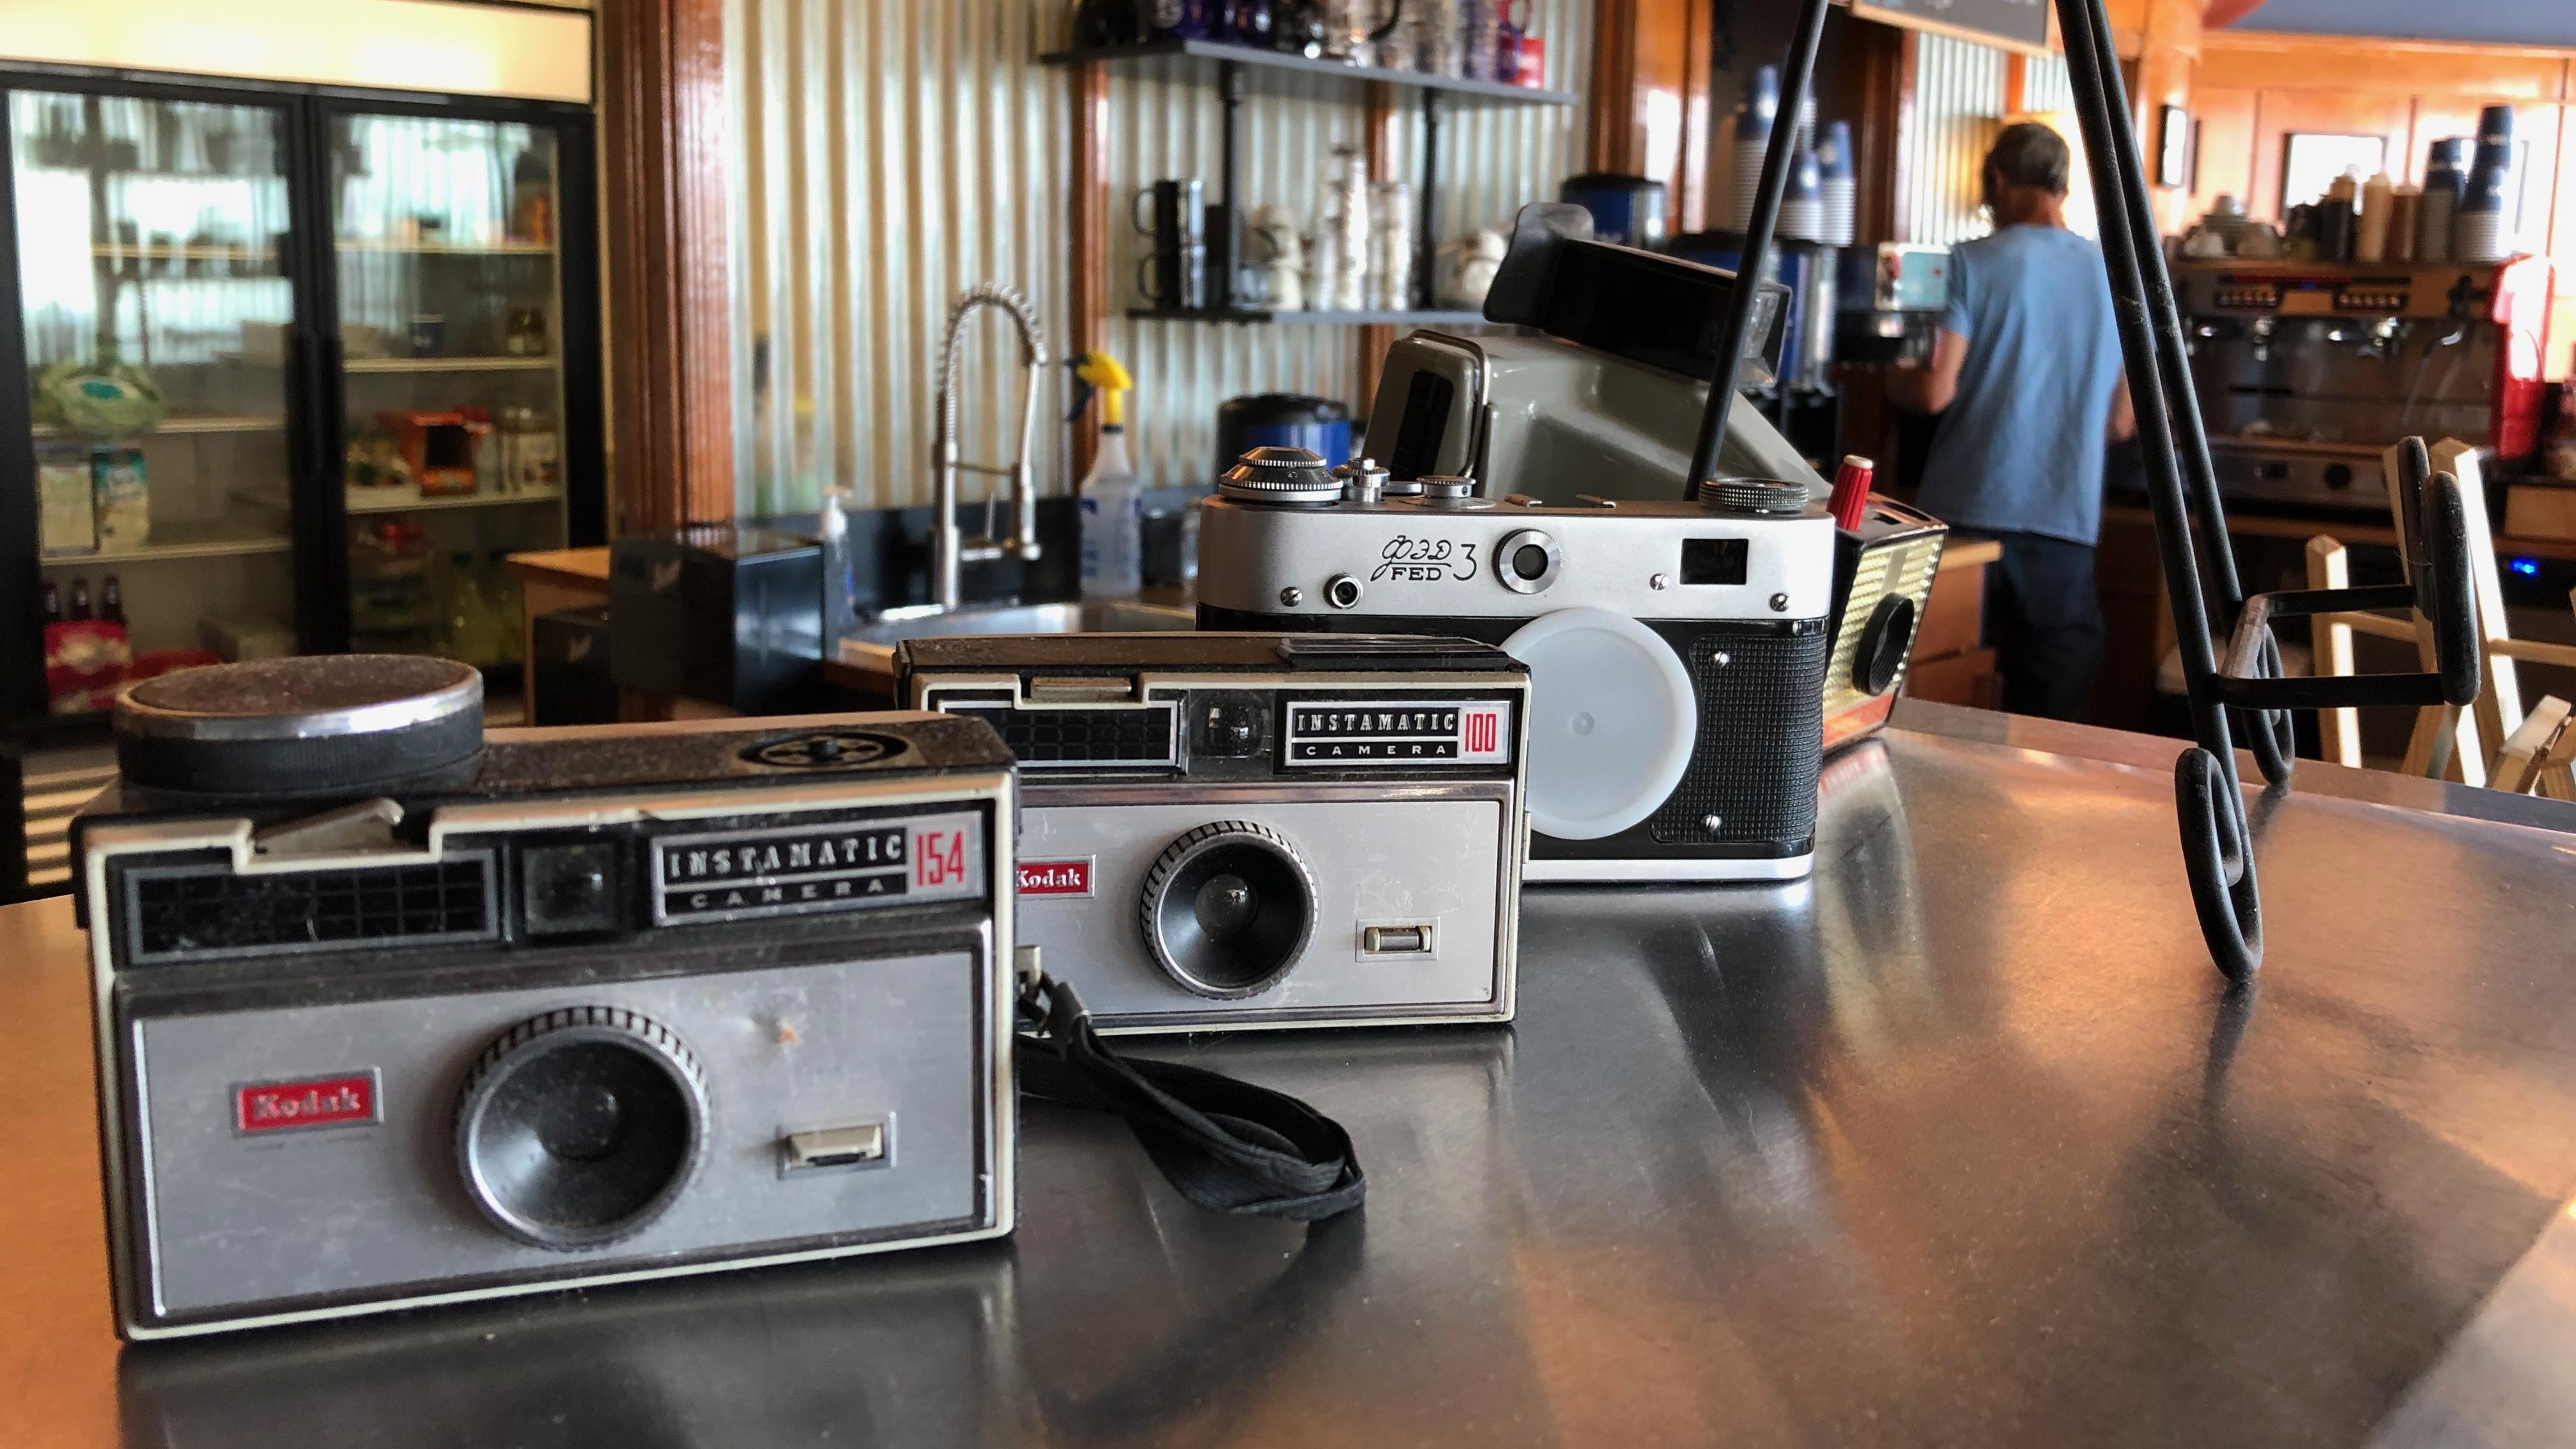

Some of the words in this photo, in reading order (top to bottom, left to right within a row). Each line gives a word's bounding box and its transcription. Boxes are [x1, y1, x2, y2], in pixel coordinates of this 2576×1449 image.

[1390, 566, 1442, 581] FED
[1452, 543, 1477, 582] 3
[1297, 713, 1456, 732] INSTAMATIC
[1464, 713, 1496, 753] 100
[1306, 745, 1446, 756] CAMERA
[668, 834, 902, 878] INSTAMATIC
[916, 831, 965, 887] 154
[690, 878, 884, 909] CAMERA
[1015, 868, 1081, 888] Kodak
[253, 1087, 361, 1120] Kodak
